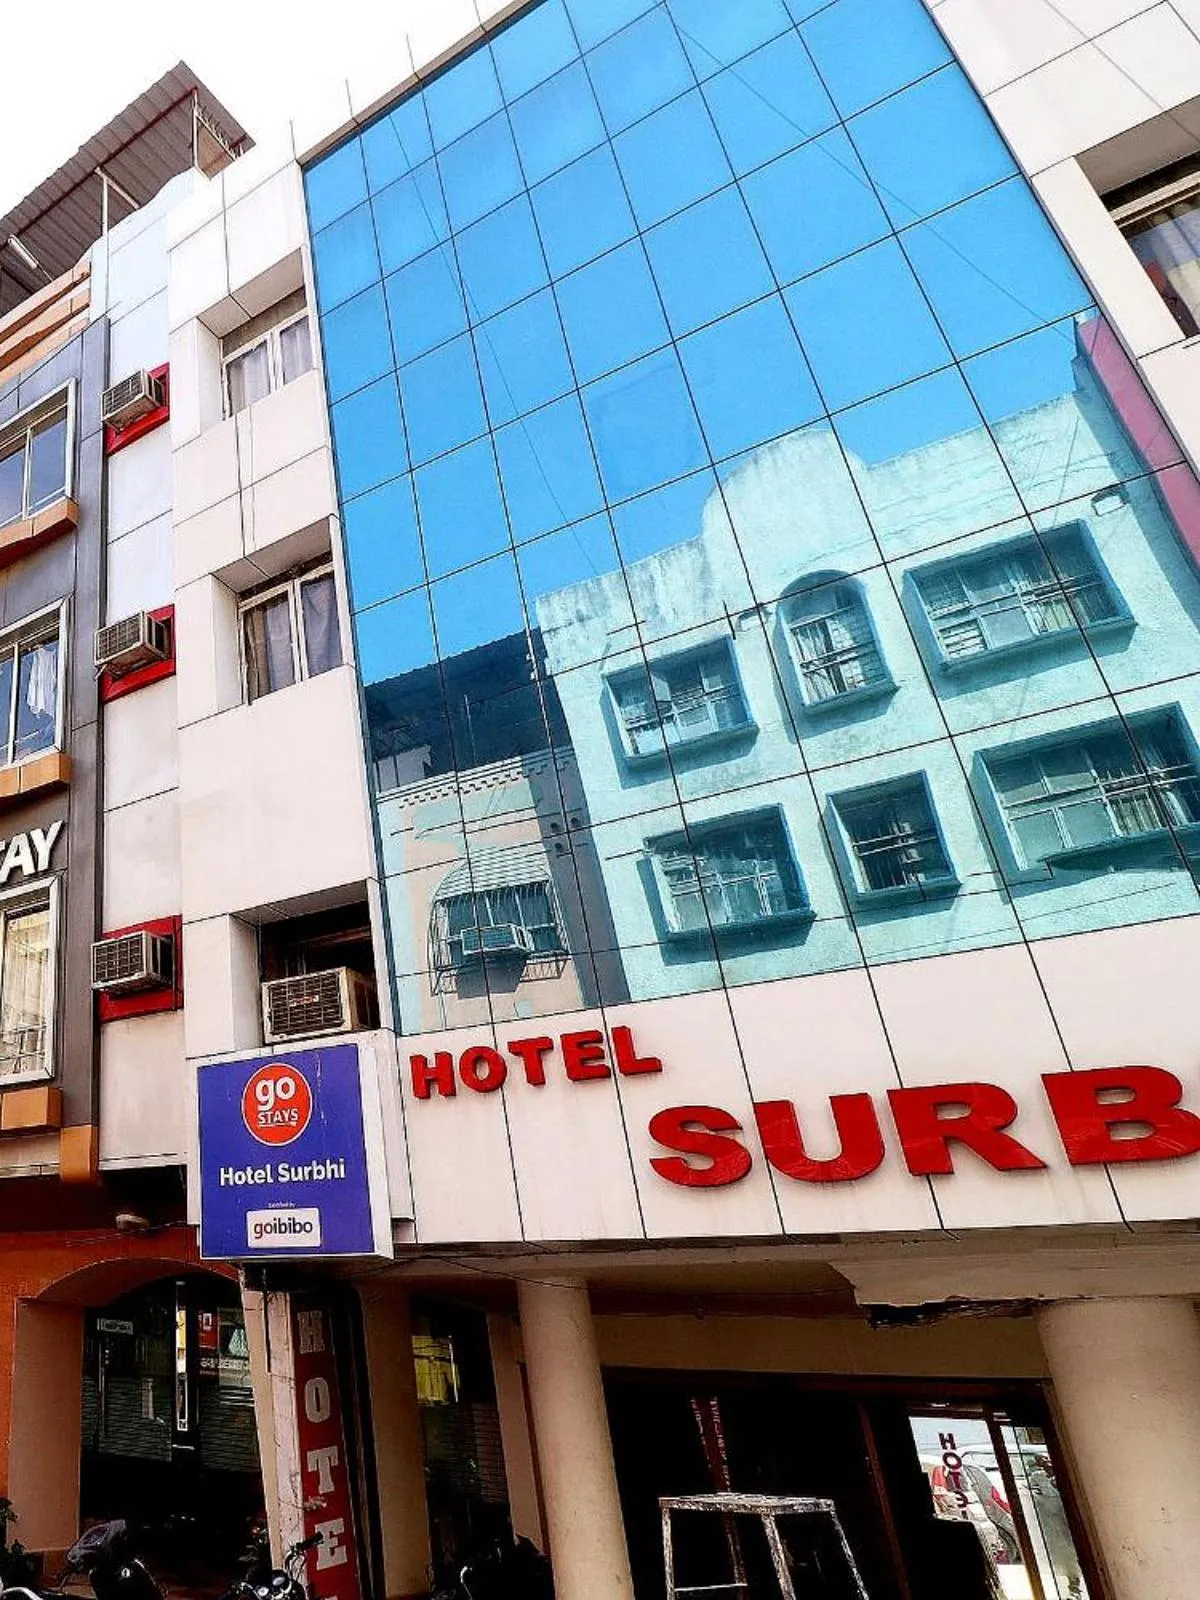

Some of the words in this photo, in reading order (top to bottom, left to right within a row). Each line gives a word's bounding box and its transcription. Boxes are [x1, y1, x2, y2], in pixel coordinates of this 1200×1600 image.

[410, 1024, 662, 1100] HOTEL
[255, 1076, 296, 1111] go
[257, 1108, 299, 1127] STAYS
[649, 1064, 1200, 1189] SURB
[220, 1163, 273, 1187] Hotel
[278, 1158, 346, 1183] Surbhi
[254, 1217, 313, 1239] goibibo
[297, 1310, 347, 1600] HOTE
